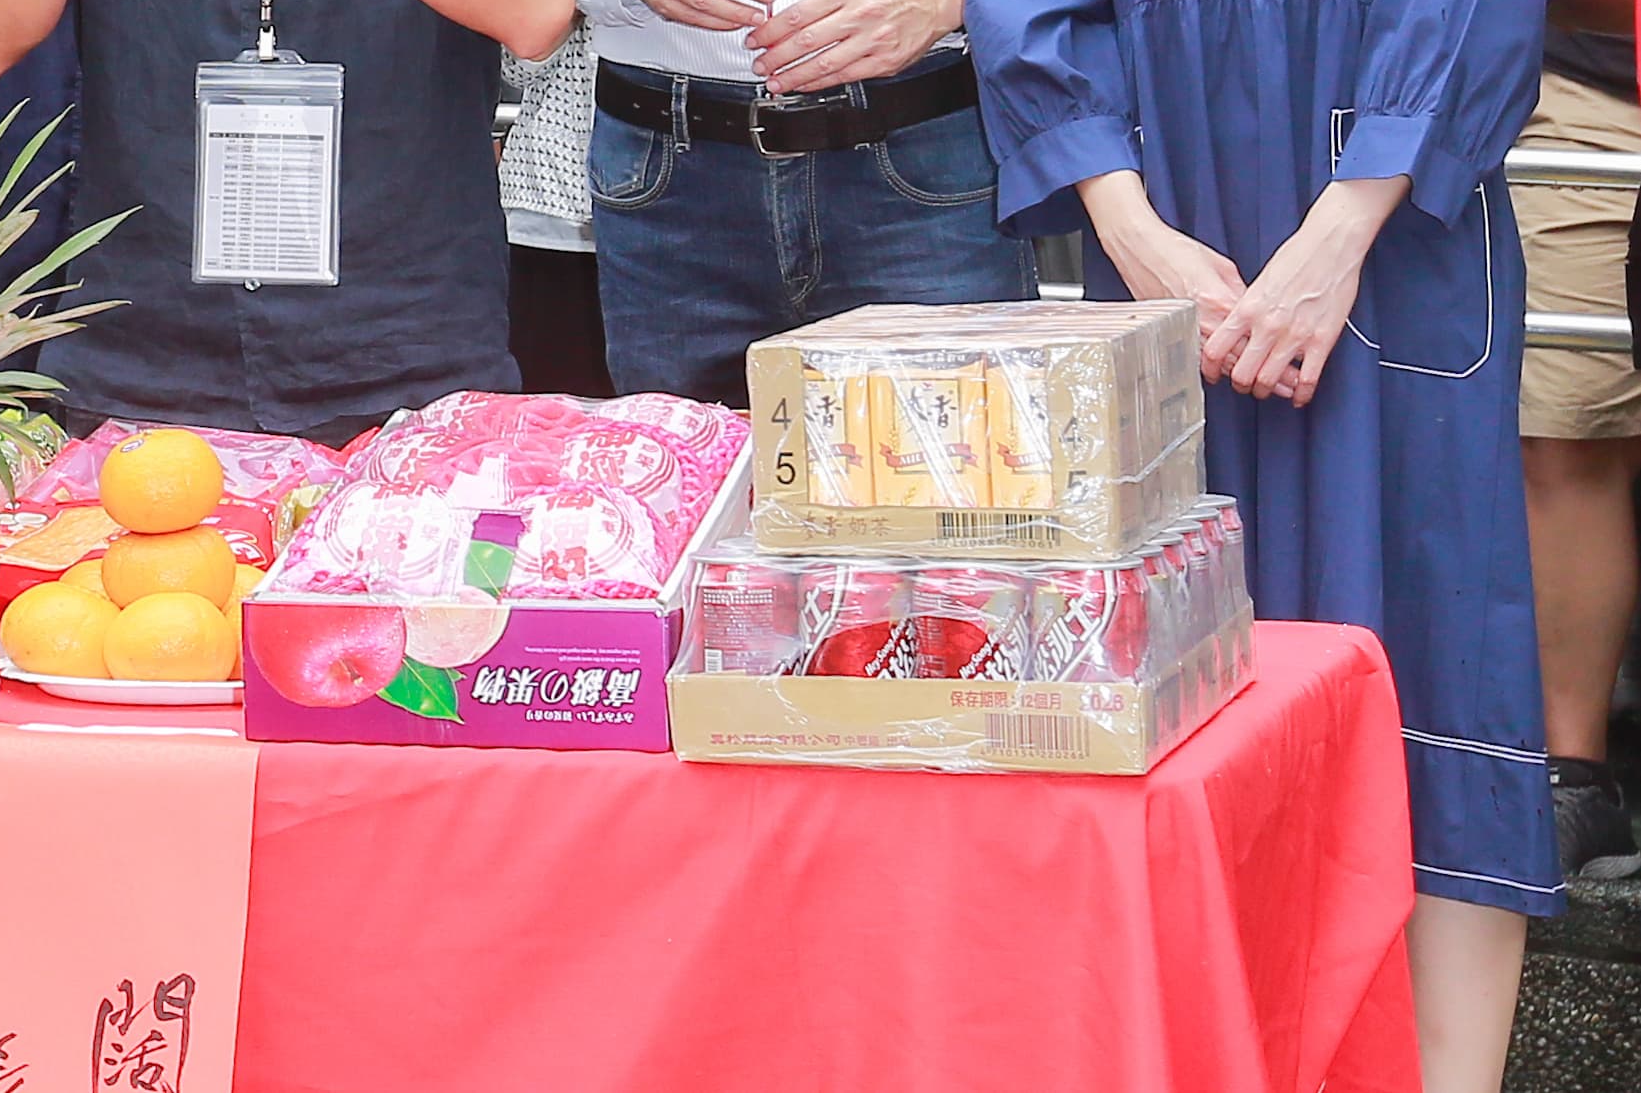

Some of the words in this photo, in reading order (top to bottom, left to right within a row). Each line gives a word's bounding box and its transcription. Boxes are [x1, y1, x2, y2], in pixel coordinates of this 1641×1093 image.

[771, 397, 792, 431] 4
[776, 452, 796, 485] 5
[471, 667, 641, 707] 高級の果物
